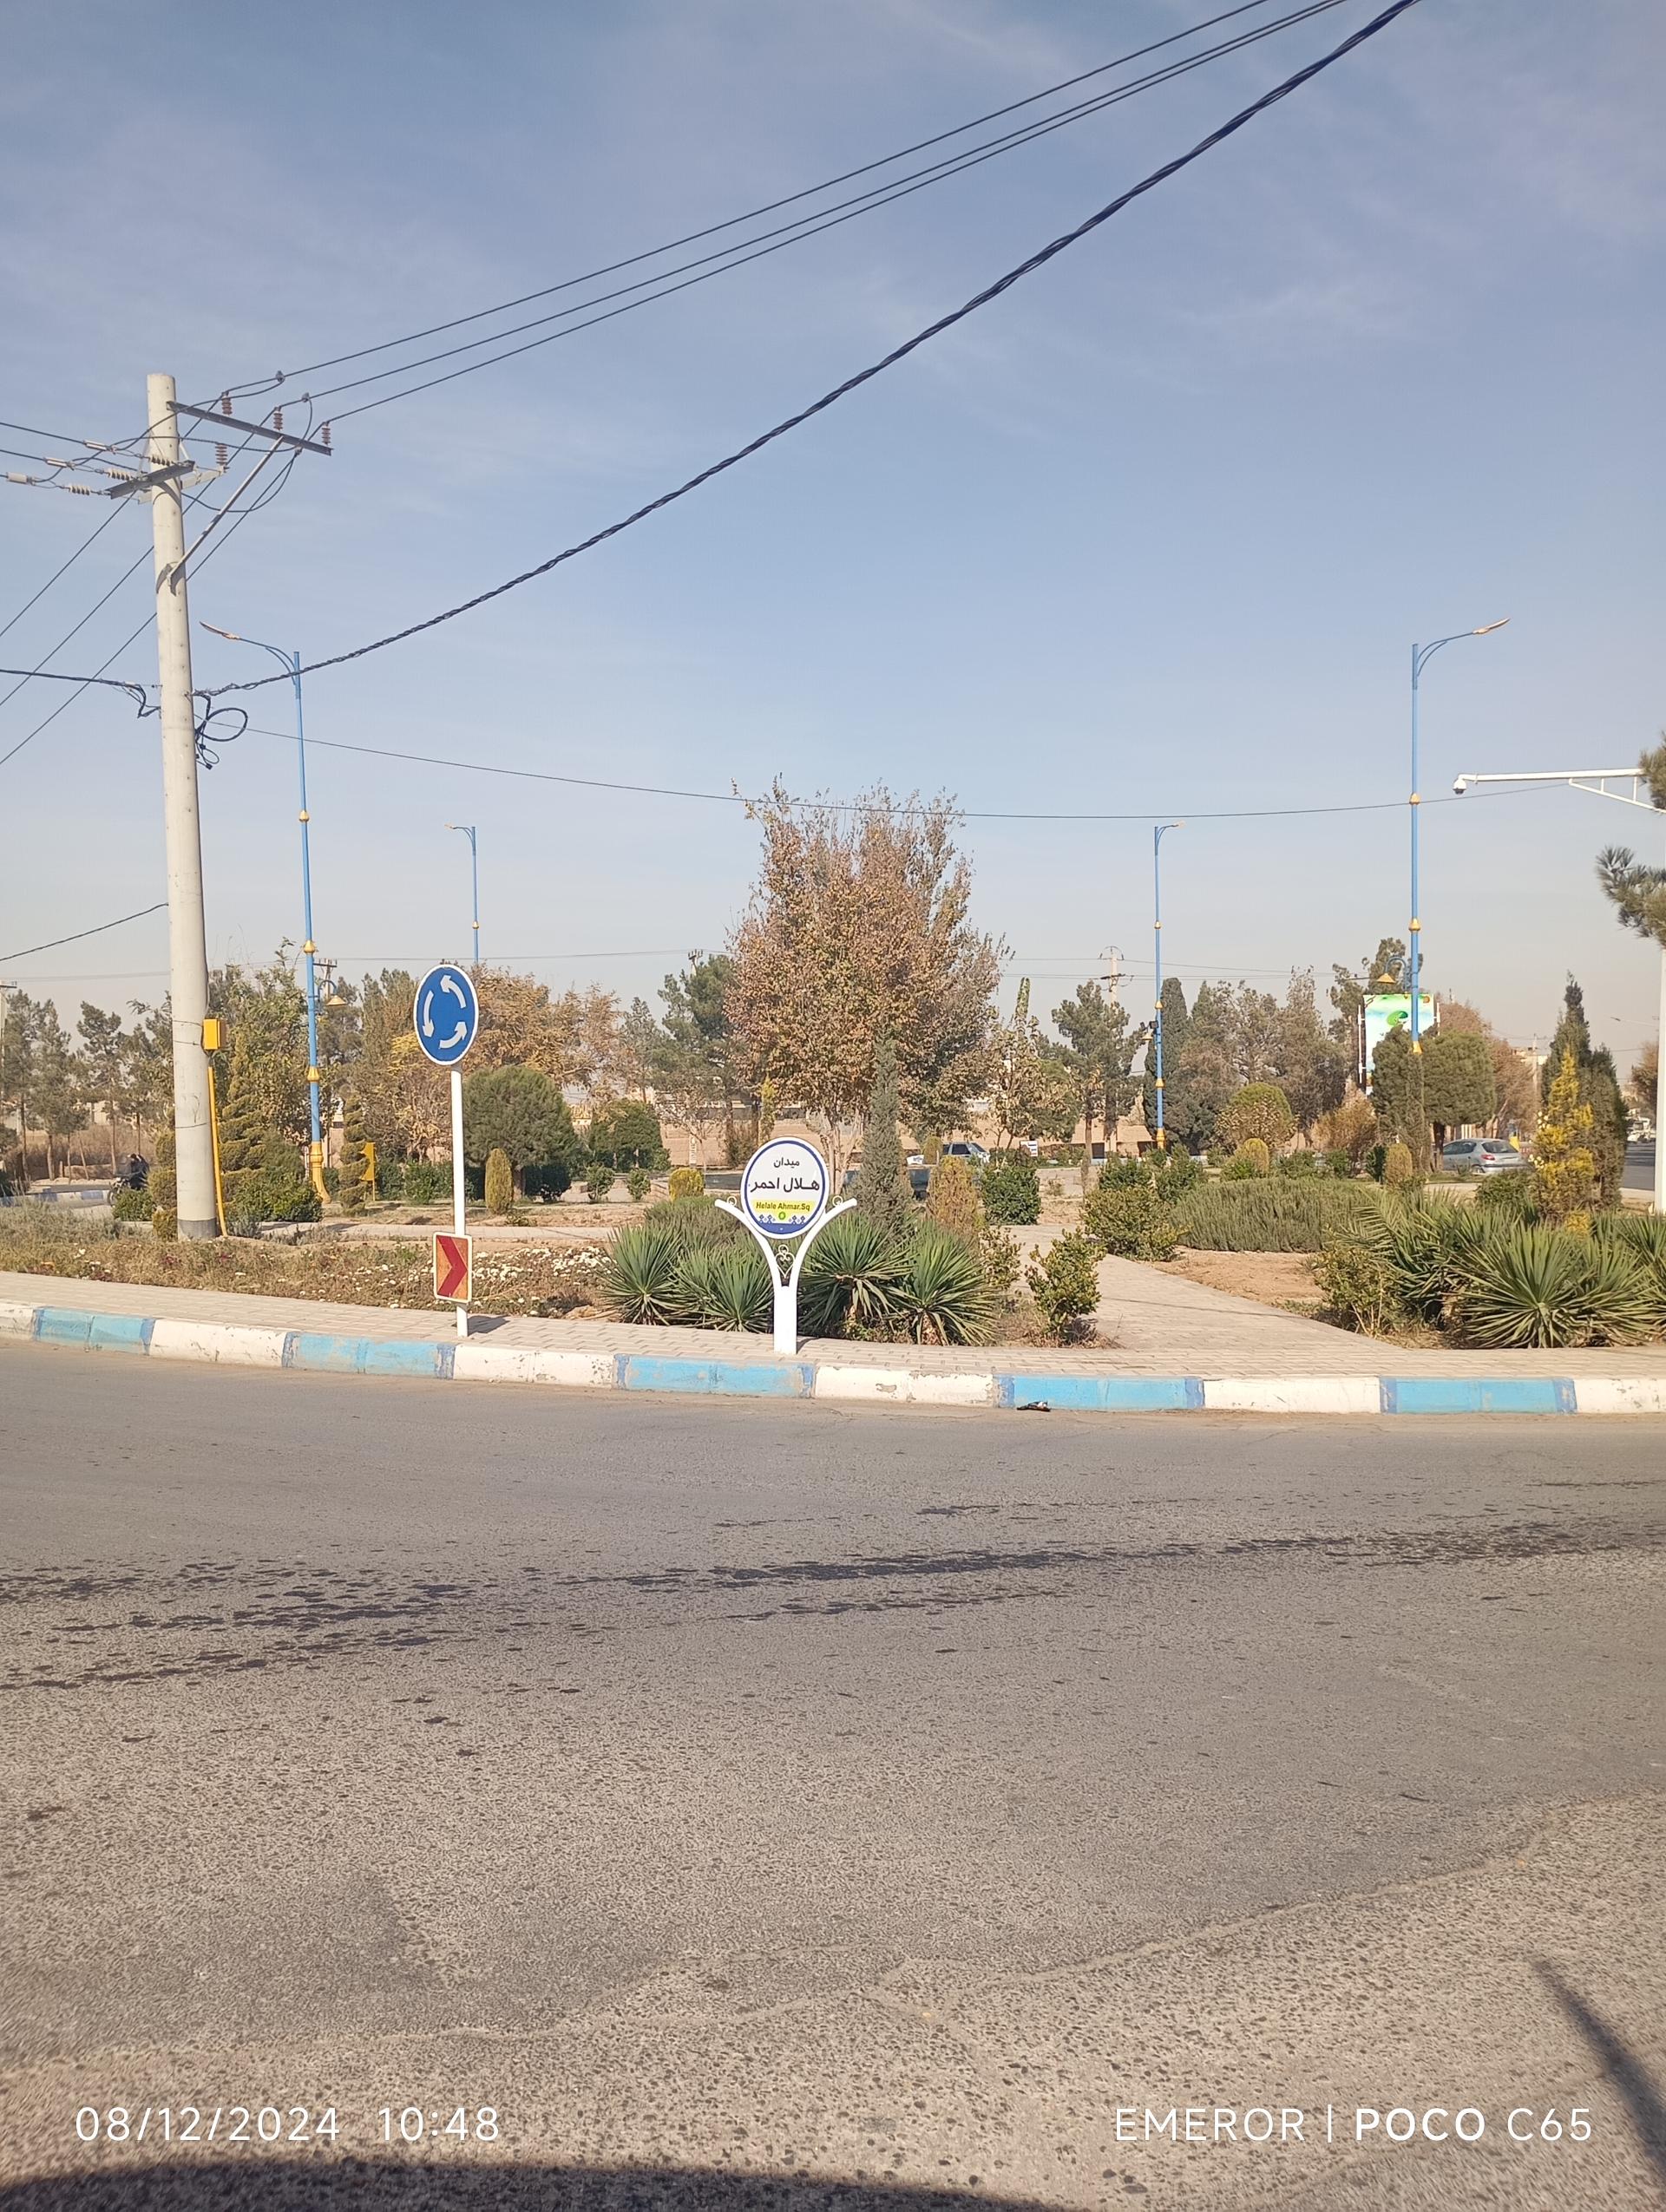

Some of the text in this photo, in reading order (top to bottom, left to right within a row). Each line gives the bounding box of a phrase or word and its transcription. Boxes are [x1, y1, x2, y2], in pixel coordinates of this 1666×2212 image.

[774, 1156, 800, 1168] میدان
[750, 1177, 820, 1193] هلال احمر
[756, 1201, 777, 1210] Helale
